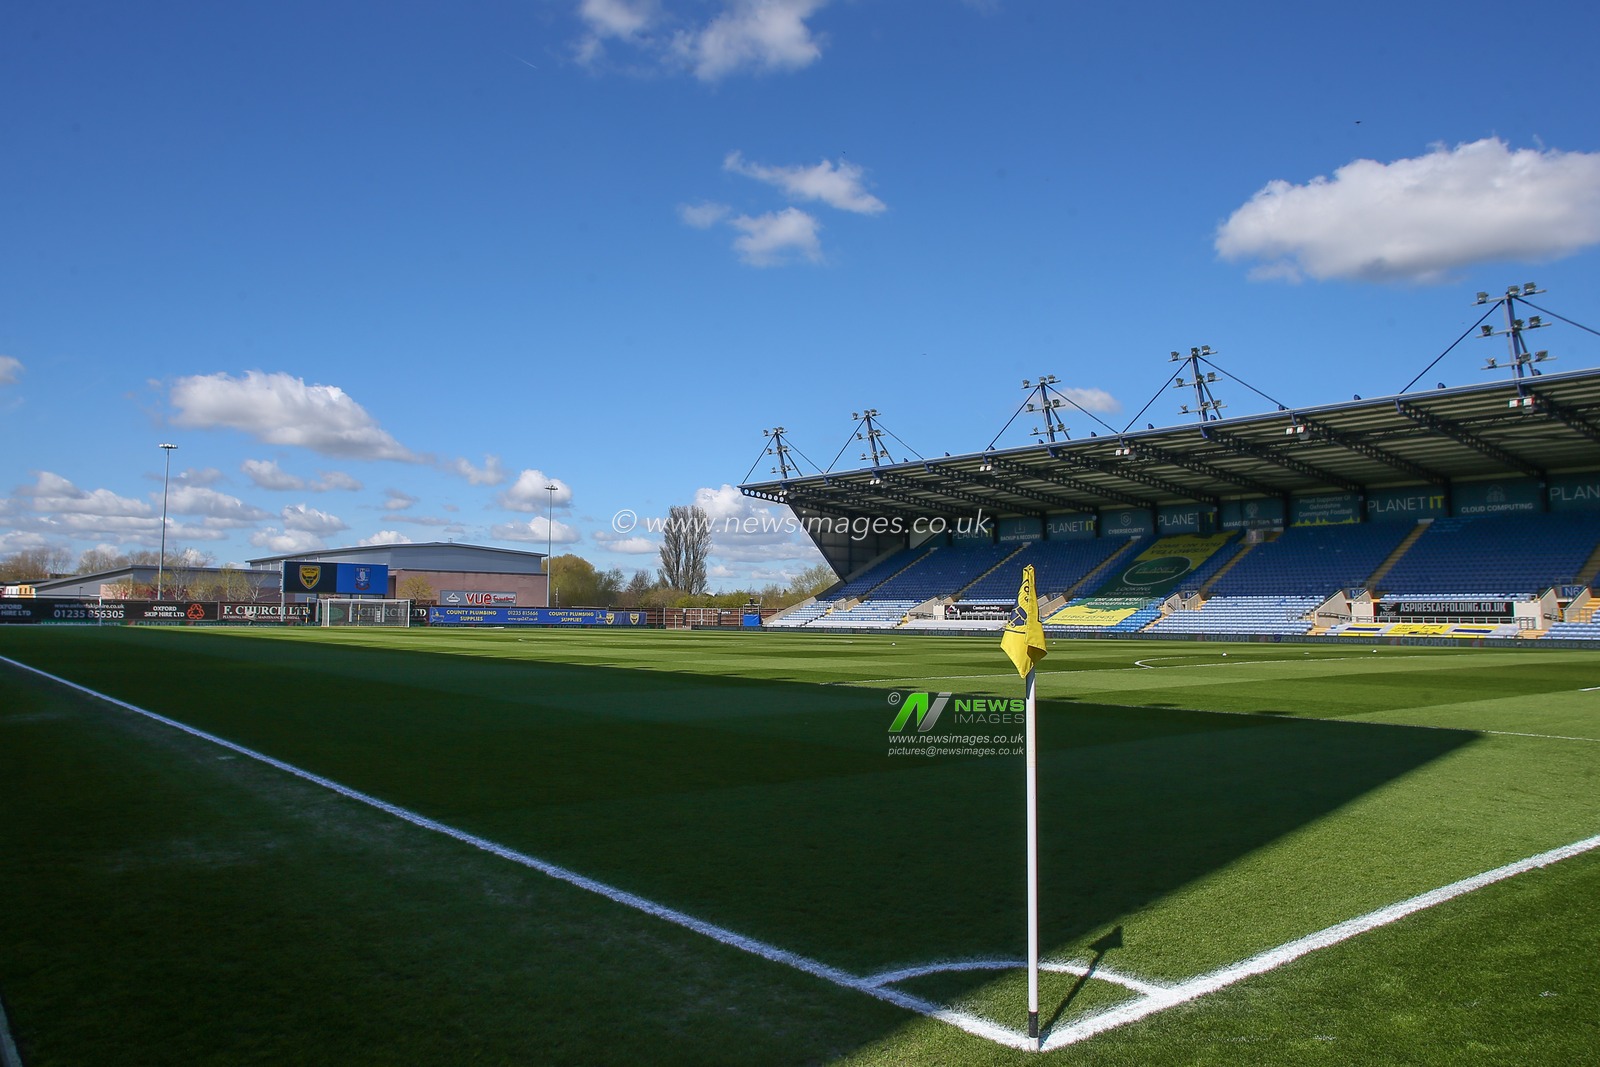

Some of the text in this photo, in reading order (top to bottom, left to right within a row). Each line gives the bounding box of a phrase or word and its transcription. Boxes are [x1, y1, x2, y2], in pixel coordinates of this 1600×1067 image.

[1316, 496, 1344, 504] Supporter
[1367, 495, 1444, 513] PLANET IT
[1309, 502, 1341, 510] Oxfordshire
[1461, 502, 1533, 514] CLOUD COMPUTING
[1298, 508, 1353, 518] Community Football
[1047, 520, 1095, 534] PLANET IT
[1108, 527, 1145, 535] CYBERSECURITY
[1020, 533, 1041, 541] RECOVERY
[223, 605, 311, 616] F. CHURCH LTD
[1400, 602, 1506, 613] ASPIRESCAFFOLDING.CO.UK
[54, 609, 125, 619] 01235 856305
[1204, 635, 1250, 643] CHAOKOH
[1400, 638, 1460, 647] CHAOKOH
